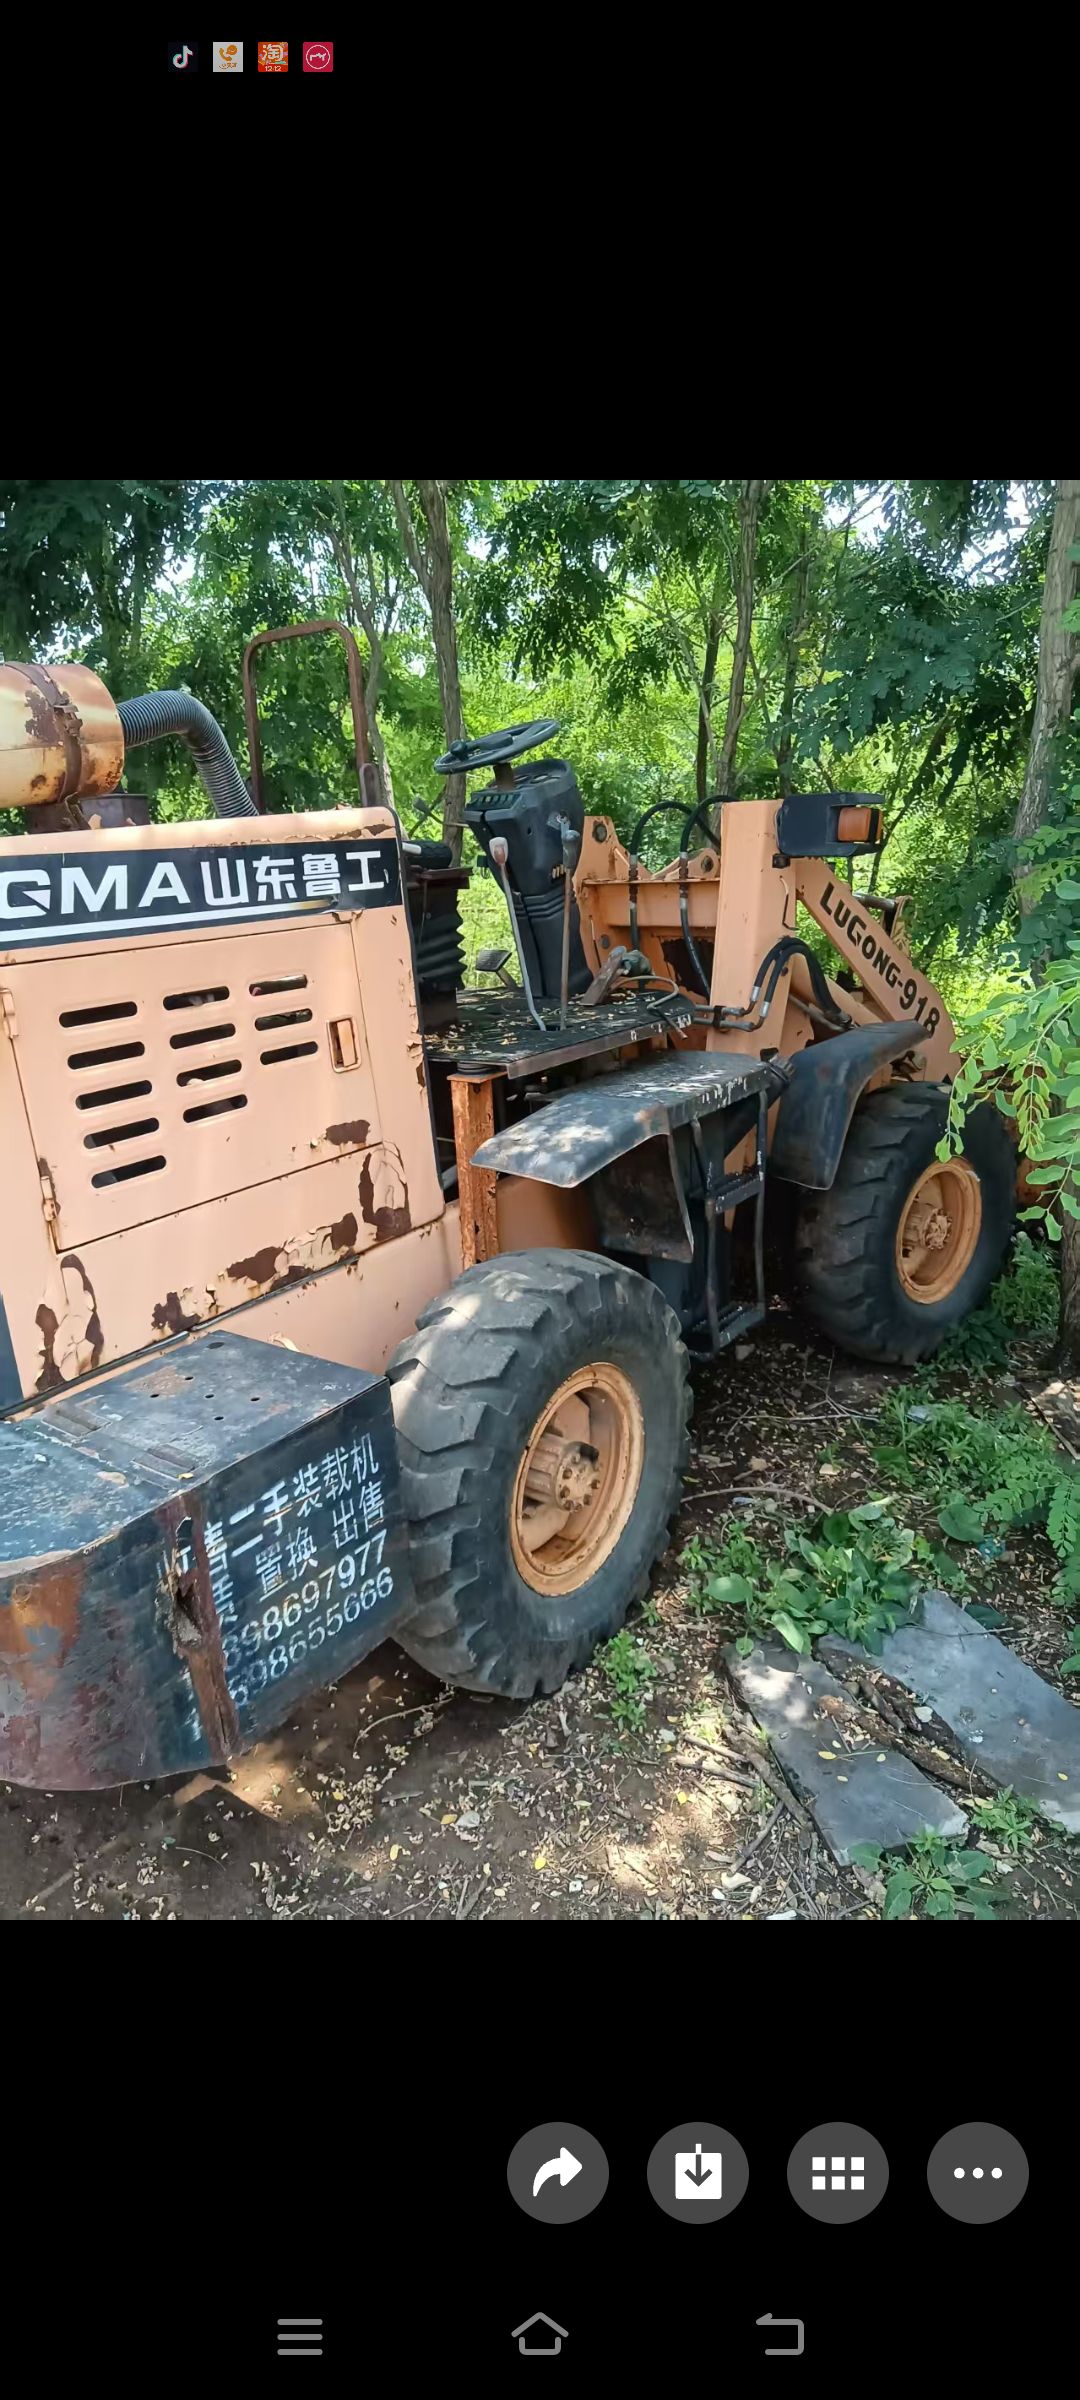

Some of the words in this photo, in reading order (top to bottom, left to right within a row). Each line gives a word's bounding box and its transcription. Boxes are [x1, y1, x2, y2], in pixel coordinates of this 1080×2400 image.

[0, 862, 191, 919] GMA
[200, 850, 385, 906] 山东鲁工
[820, 881, 940, 1039] LUGONG-918
[255, 1526, 318, 1602] 置换
[332, 1480, 384, 1549] 出售
